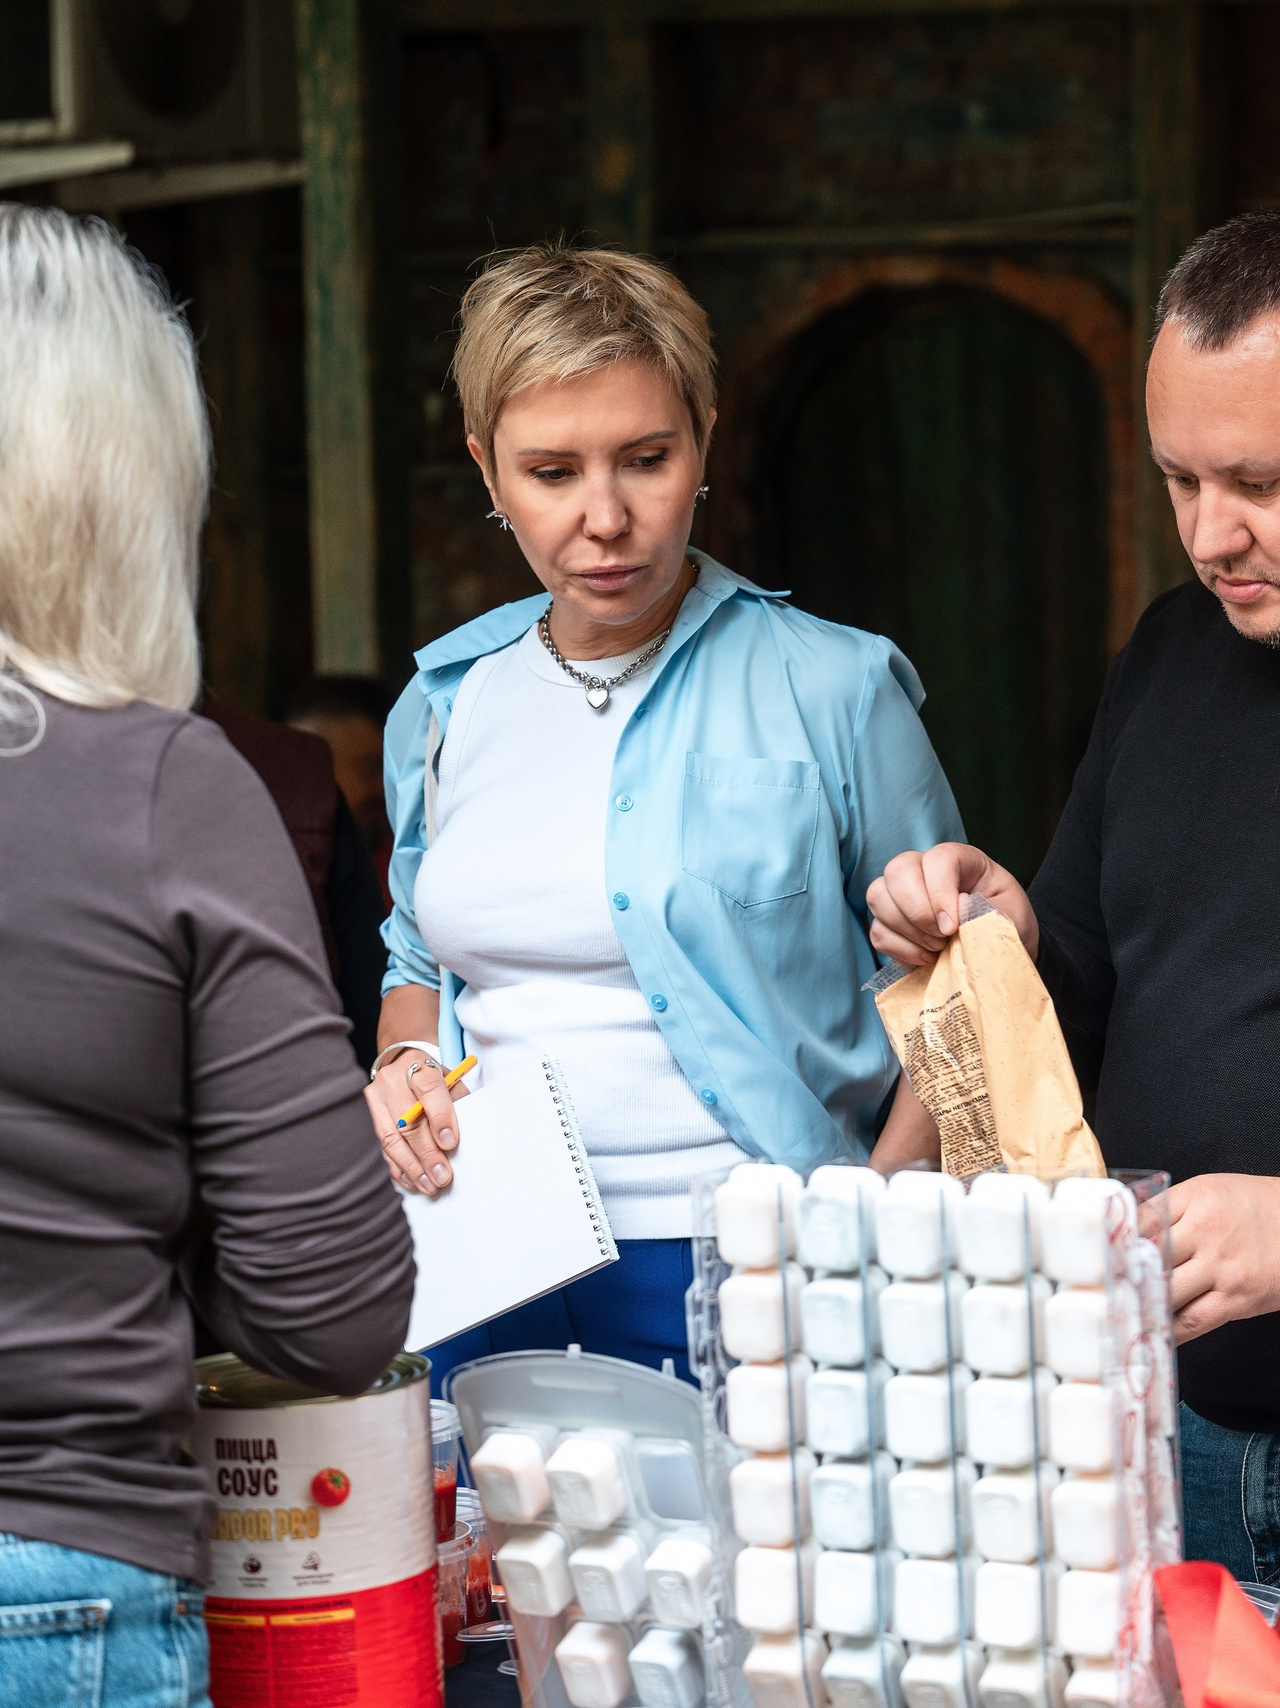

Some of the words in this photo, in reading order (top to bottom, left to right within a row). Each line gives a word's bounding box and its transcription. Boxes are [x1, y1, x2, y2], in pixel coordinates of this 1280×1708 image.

[214, 1437, 279, 1464] ПИЦЦА
[217, 1467, 279, 1497] СОУС
[274, 1506, 320, 1541] PRO
